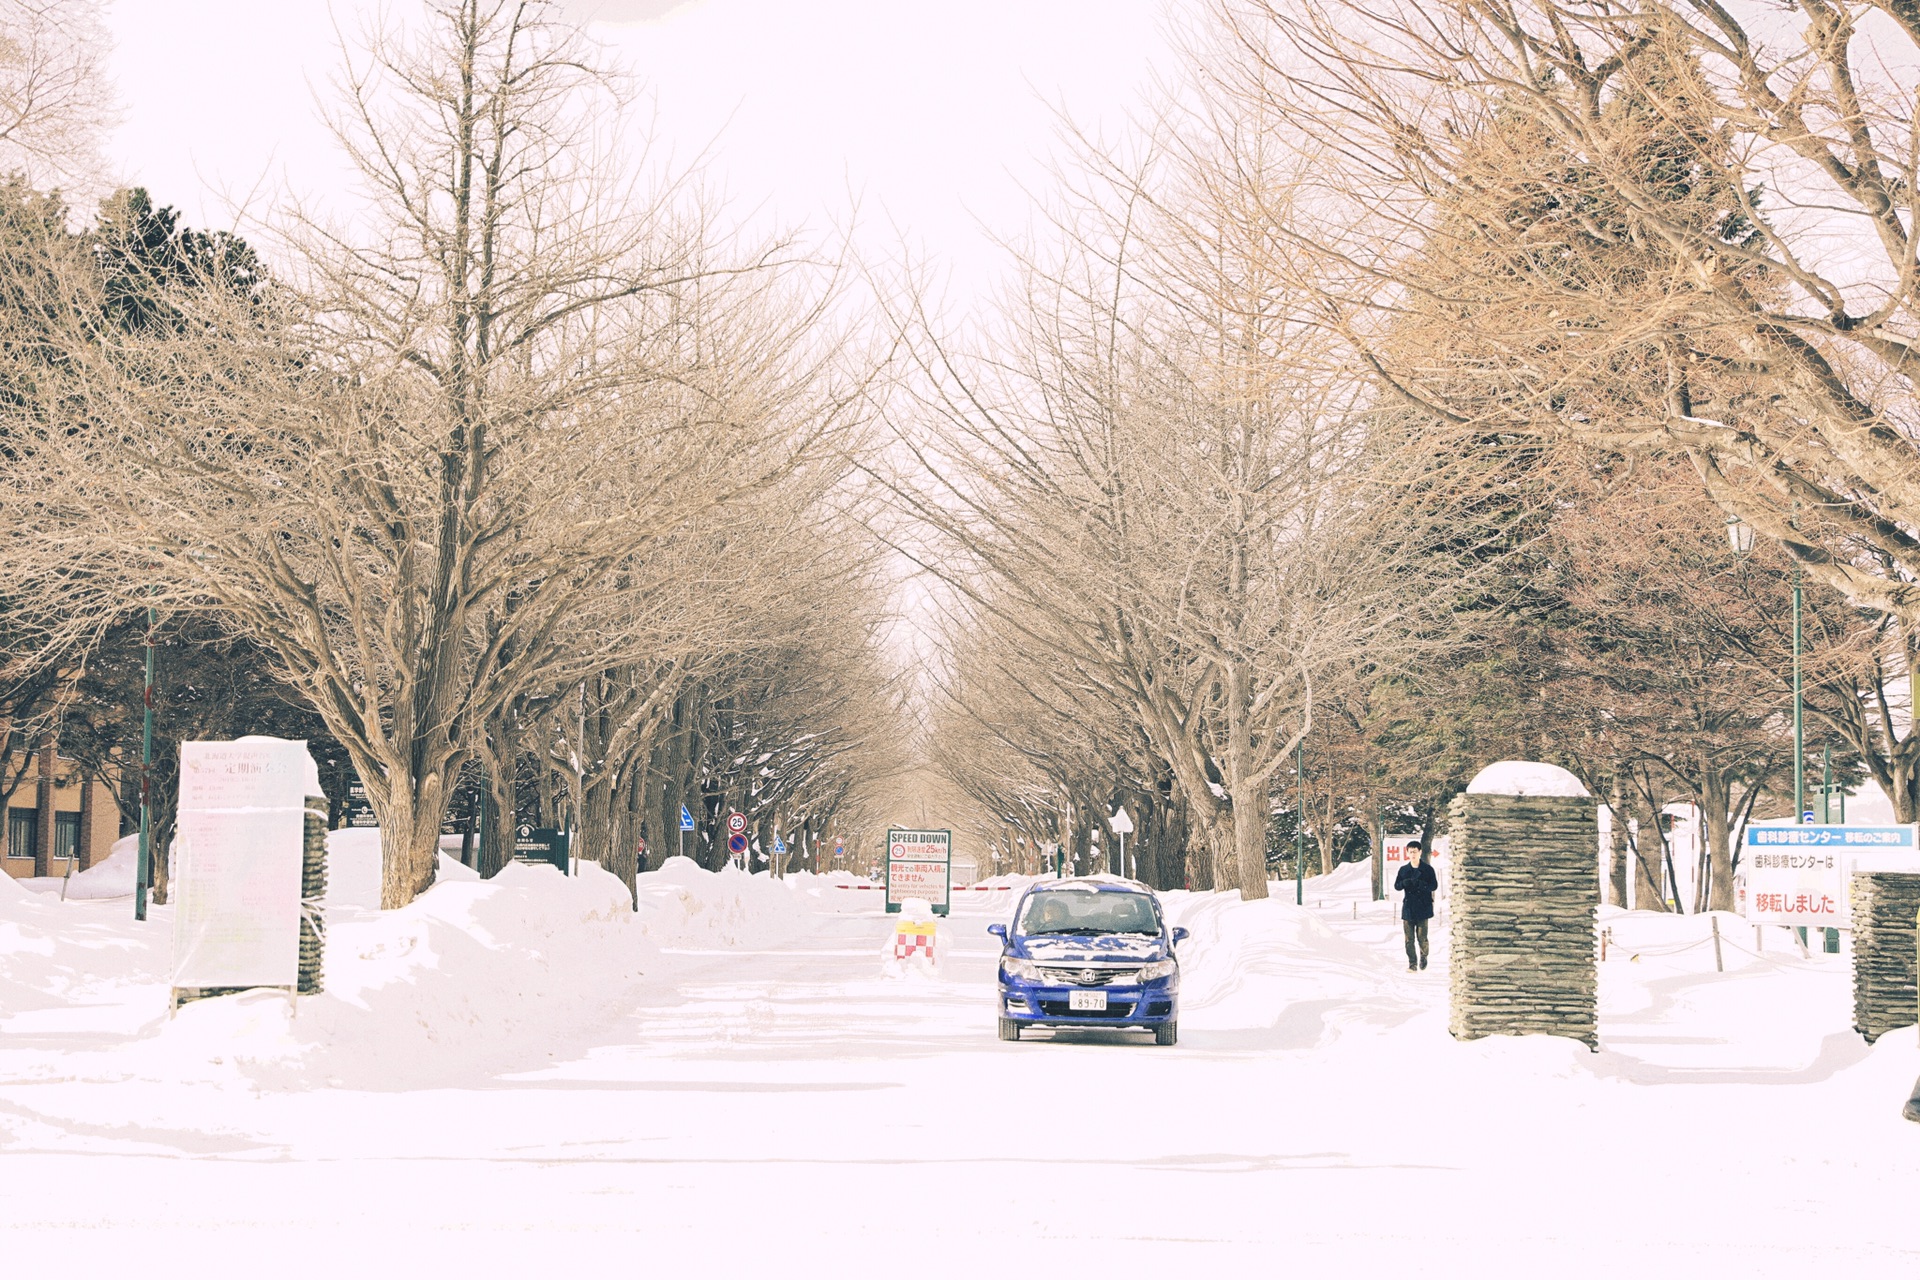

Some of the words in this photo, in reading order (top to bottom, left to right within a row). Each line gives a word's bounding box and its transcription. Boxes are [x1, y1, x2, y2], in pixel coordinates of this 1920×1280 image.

[732, 817, 743, 828] 25
[891, 833, 918, 843] SPEED
[920, 834, 947, 844] DOWN
[1756, 830, 1842, 844] 歯科診療センター
[1845, 831, 1901, 844] 移転のご案内
[1754, 854, 1834, 869] 歯科診療センターは
[1755, 893, 1835, 913] 移転しました
[1078, 998, 1104, 1008] 89-70
